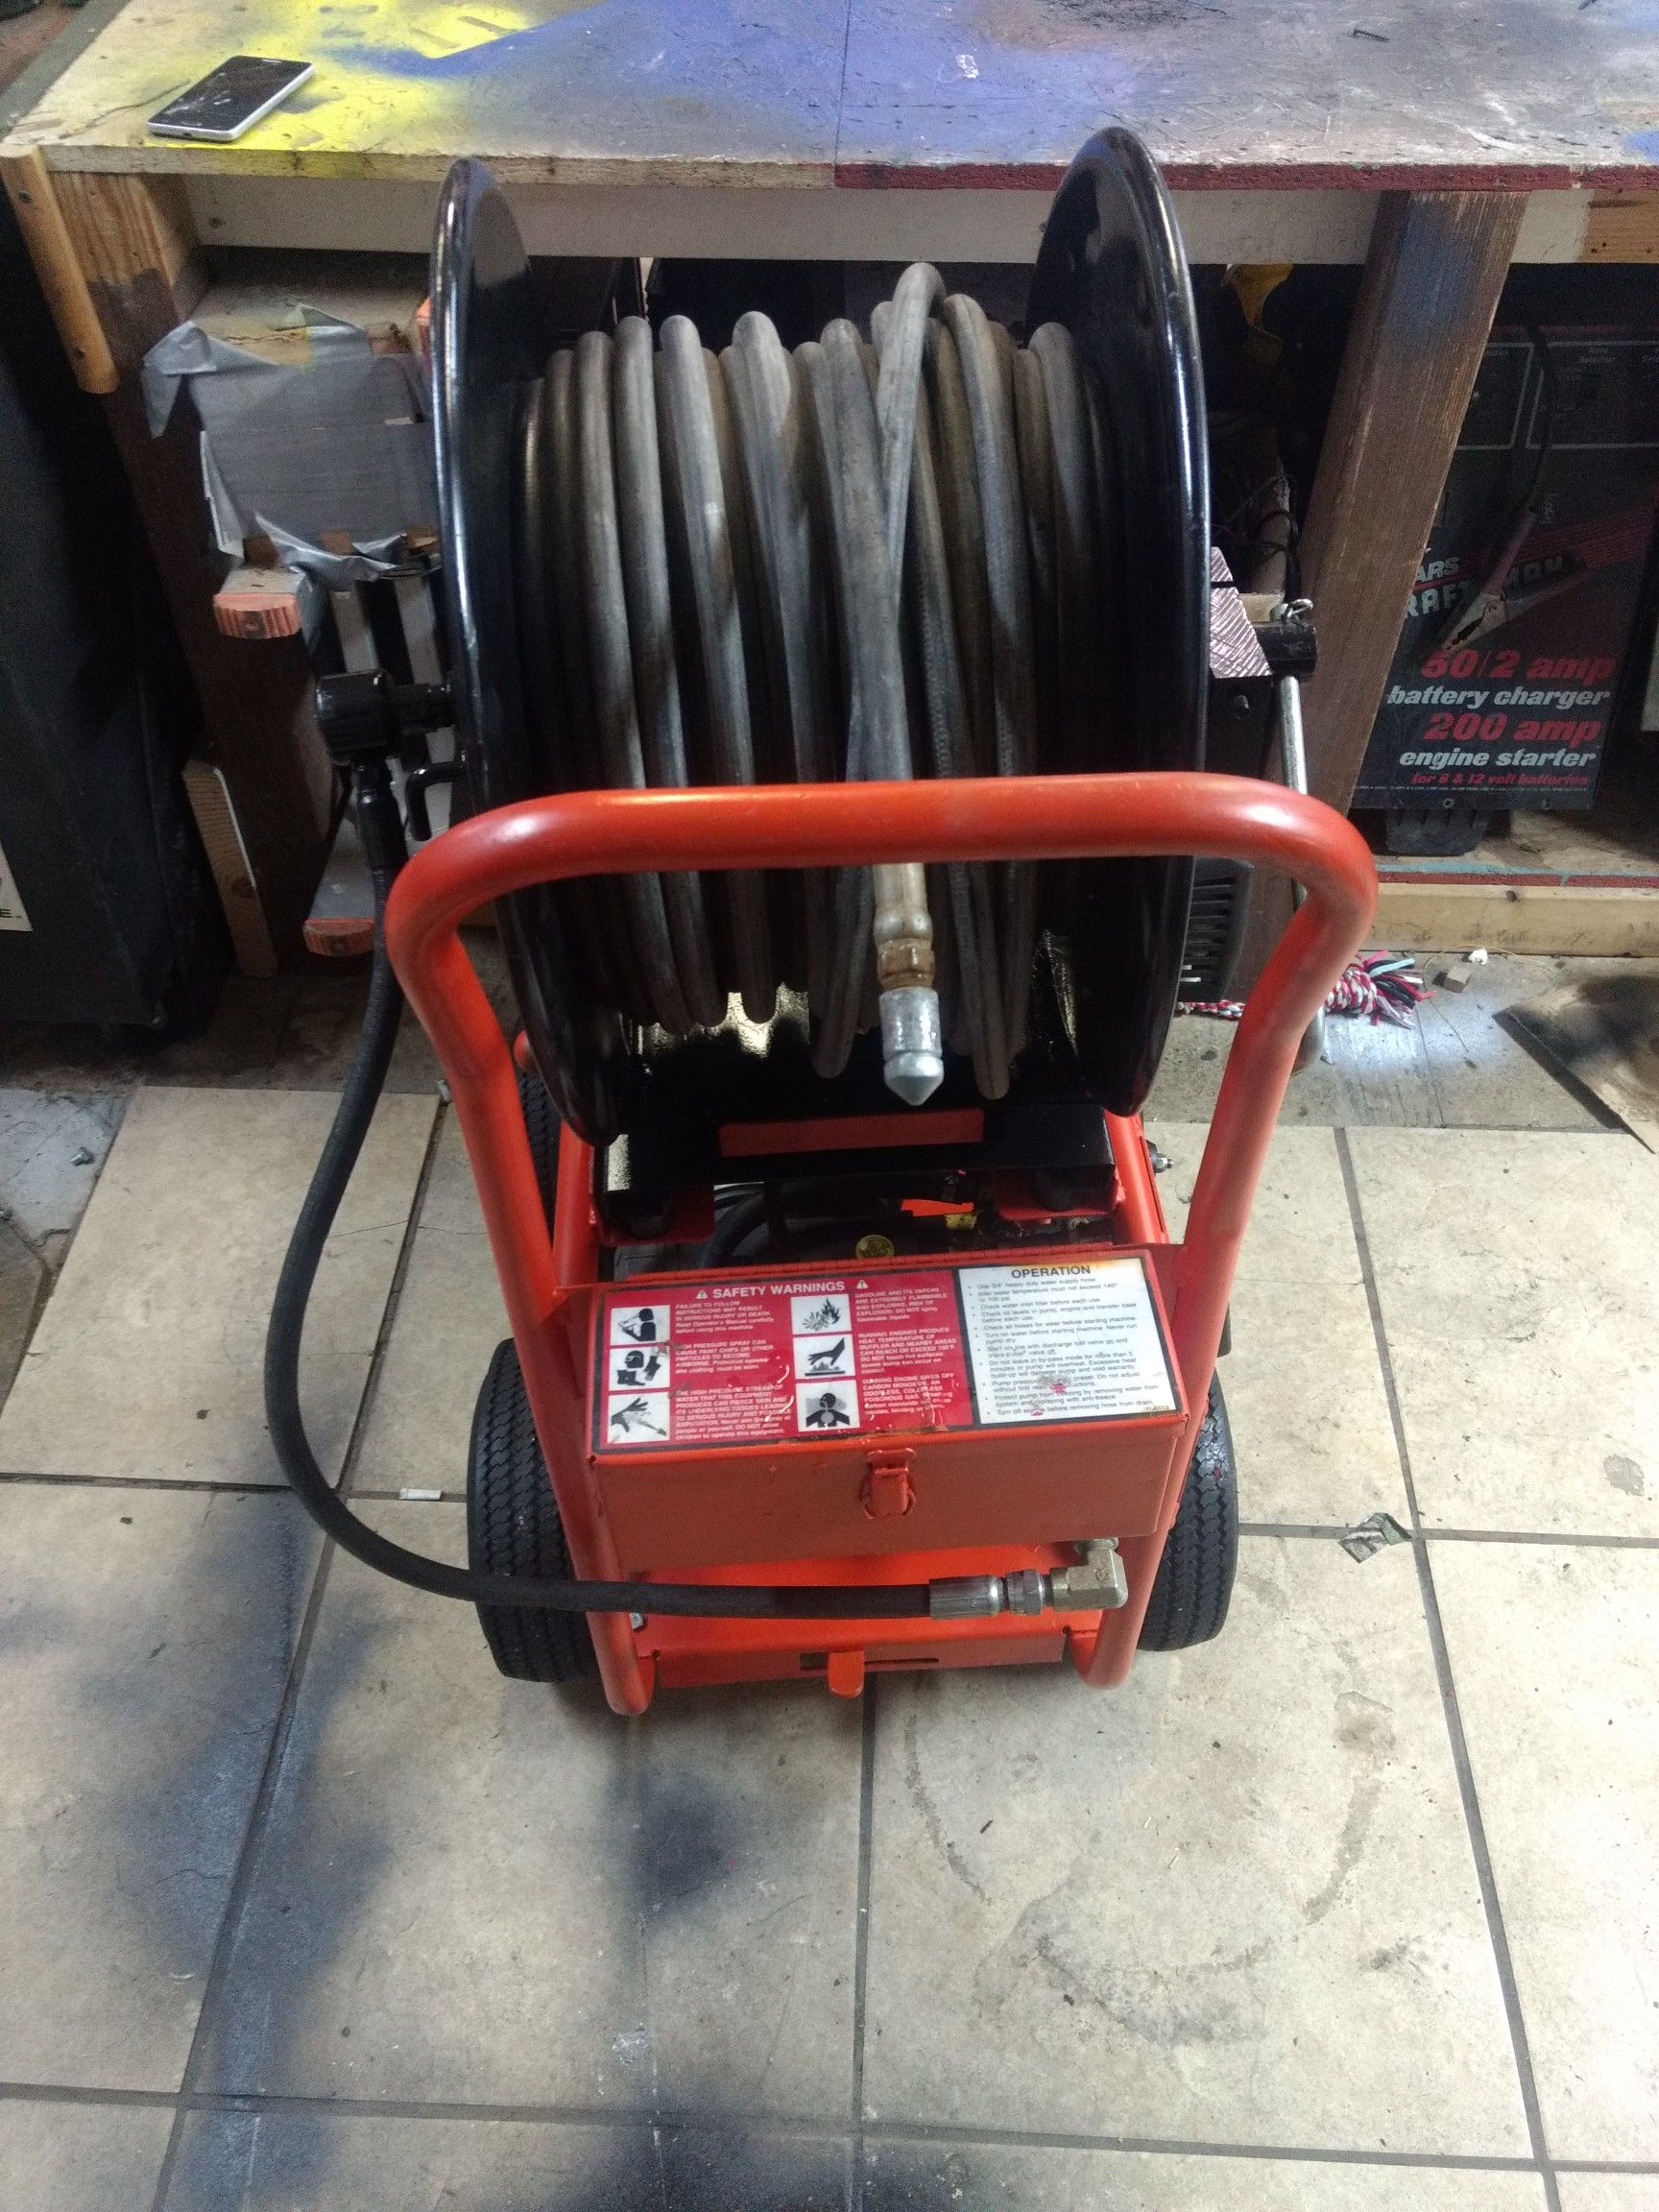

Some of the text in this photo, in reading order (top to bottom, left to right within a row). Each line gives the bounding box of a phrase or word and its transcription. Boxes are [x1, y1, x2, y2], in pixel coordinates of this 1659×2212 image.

[1527, 656, 1616, 686] amp
[1386, 685, 1610, 709] battery charger
[1423, 711, 1604, 749] 200 amp
[1399, 748, 1597, 770] engine starter
[1468, 773, 1486, 783] 12
[1488, 773, 1517, 783] volt
[1519, 774, 1588, 784] batteries
[1011, 1265, 1091, 1279] OPERATION
[713, 1281, 845, 1298] SAFETY WARNINGS
